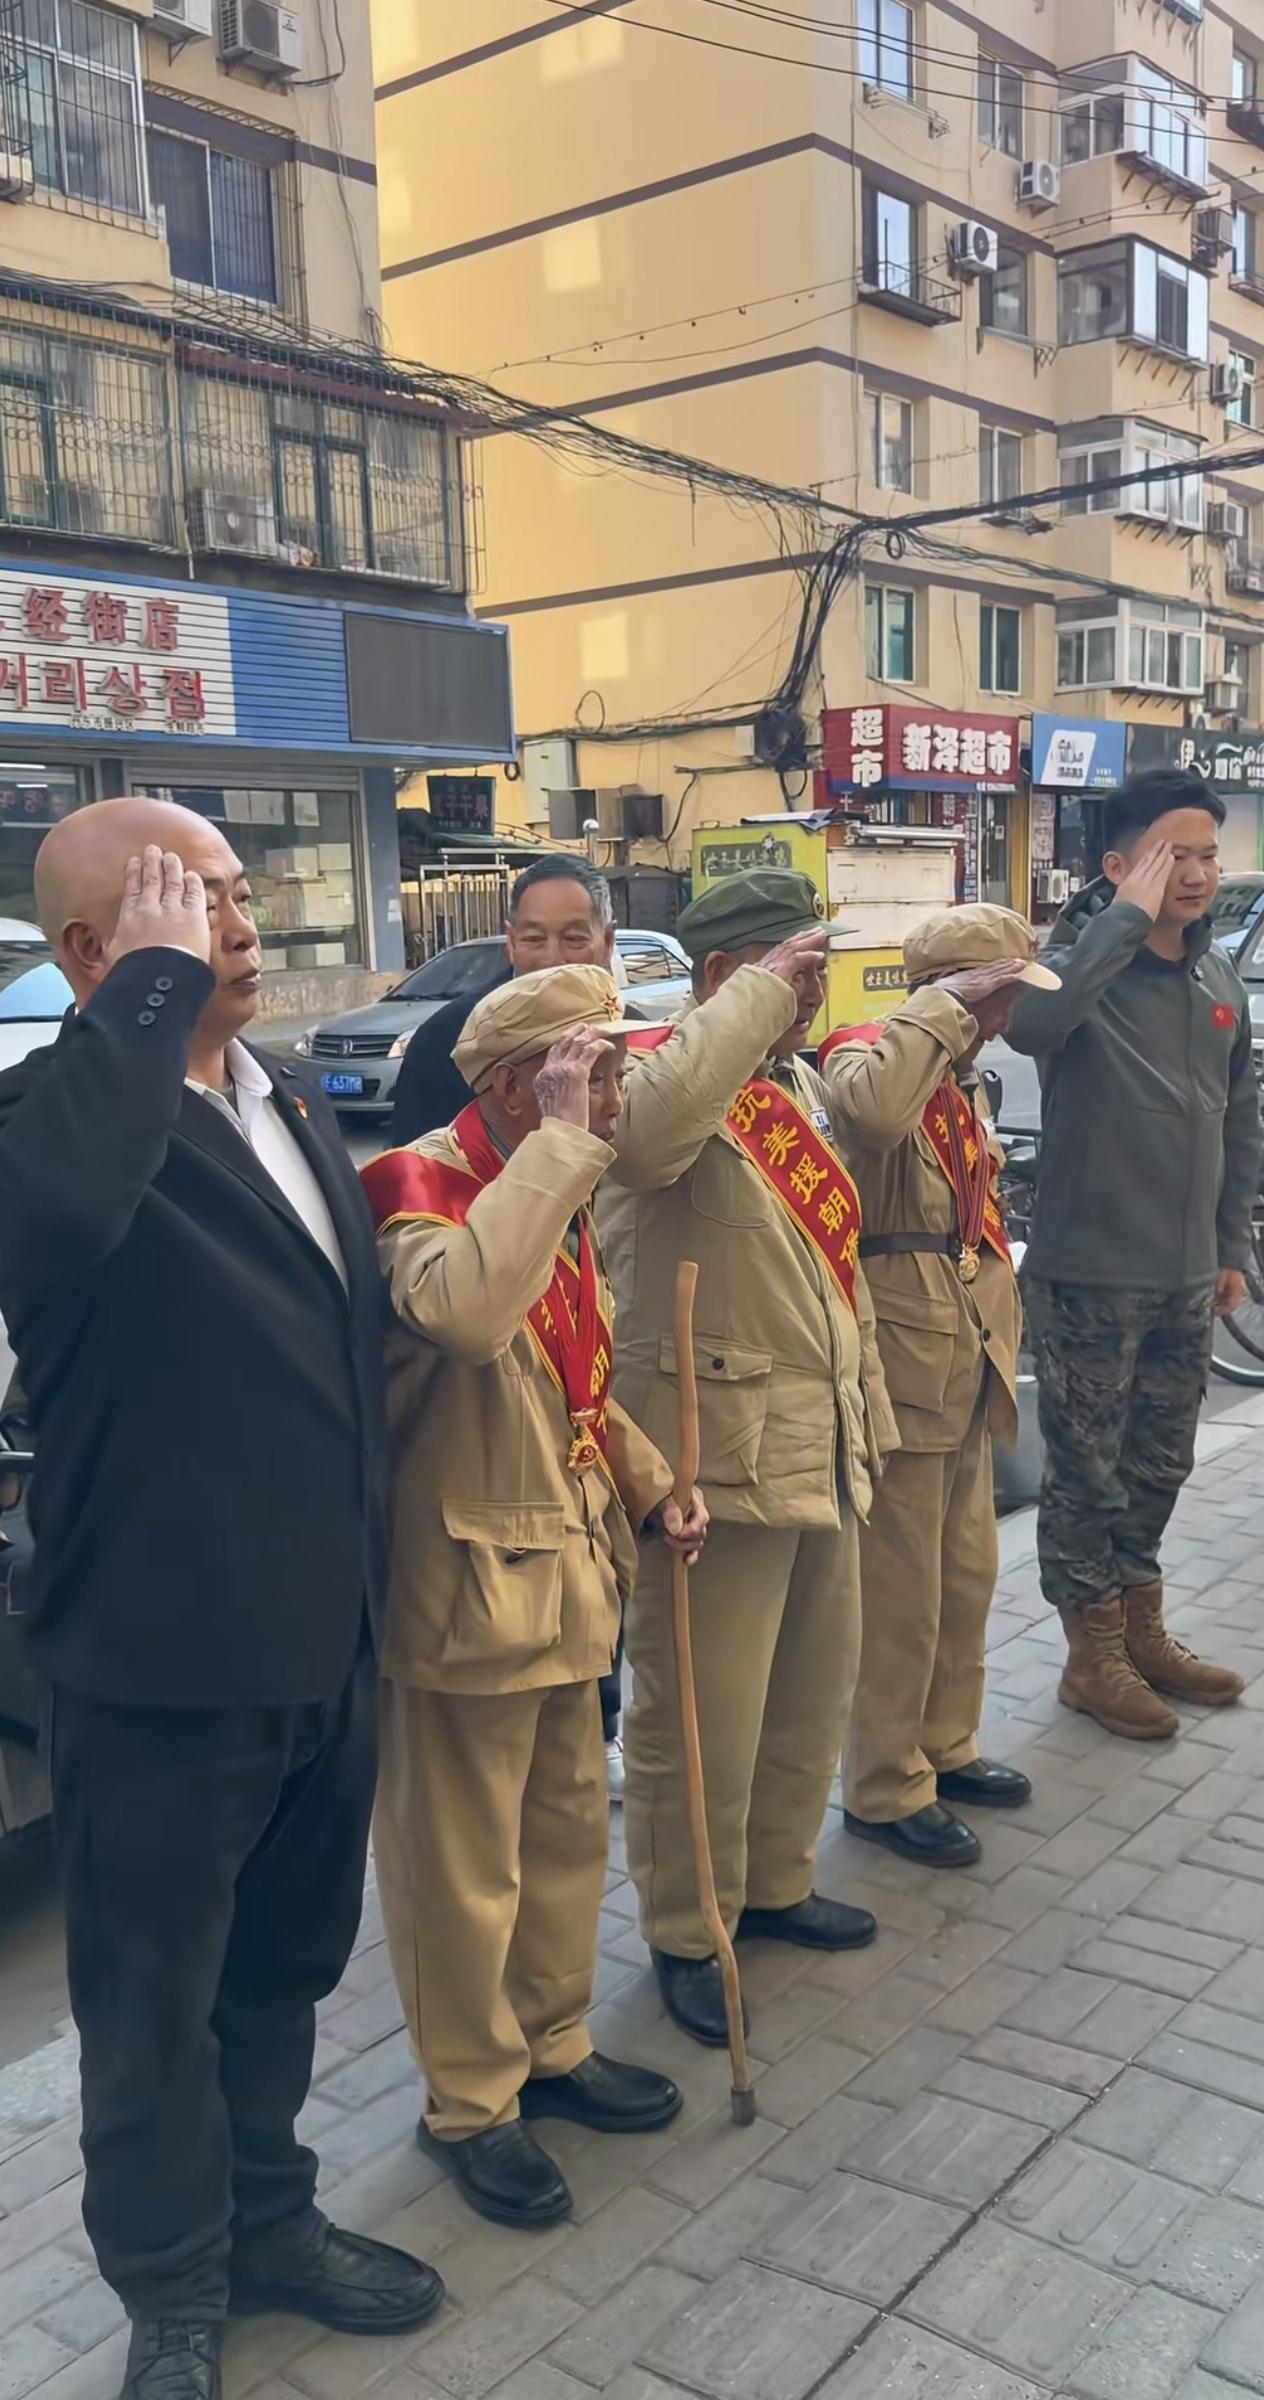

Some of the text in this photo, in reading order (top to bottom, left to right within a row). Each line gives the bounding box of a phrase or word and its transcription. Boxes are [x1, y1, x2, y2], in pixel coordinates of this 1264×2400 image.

[0, 587, 180, 651] 经街店
[851, 709, 883, 787] 超市
[903, 723, 1012, 776] 新泽超市
